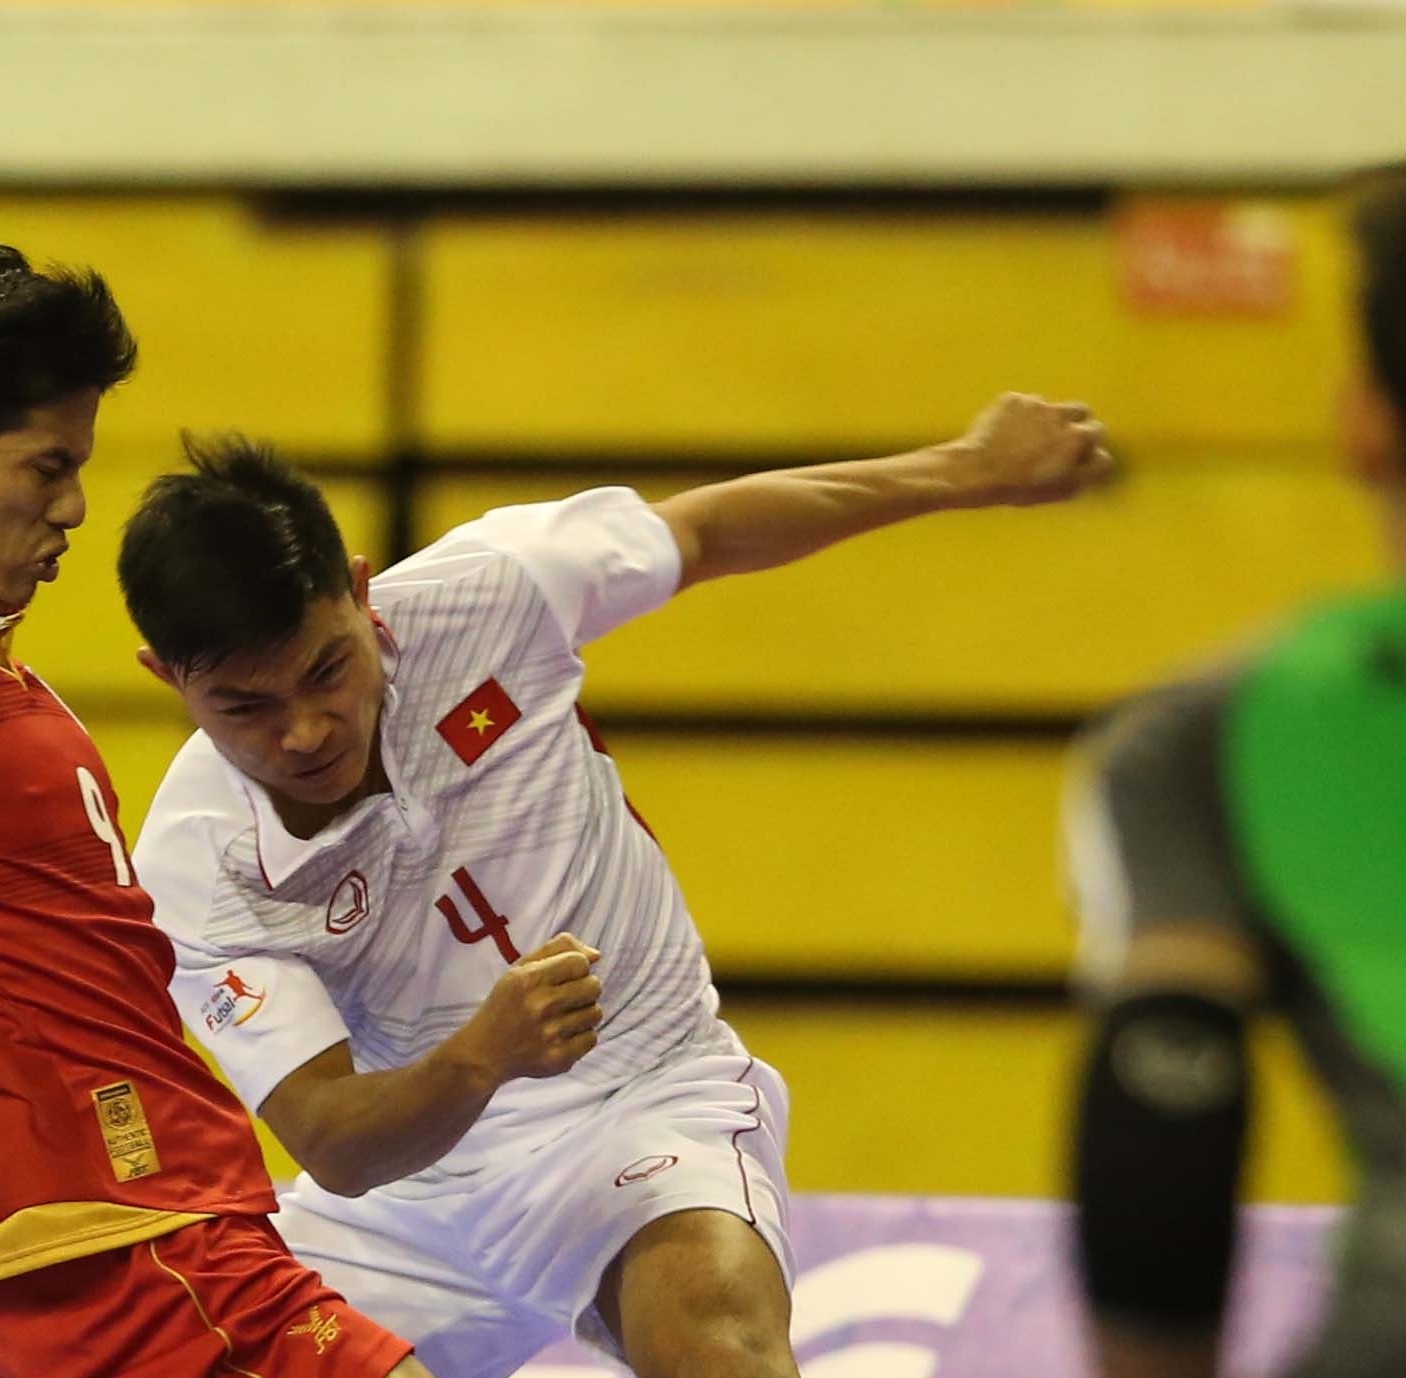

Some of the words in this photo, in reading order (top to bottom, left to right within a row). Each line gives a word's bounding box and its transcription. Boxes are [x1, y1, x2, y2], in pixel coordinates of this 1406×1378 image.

[76, 767, 131, 888] 9
[434, 866, 521, 964] 4
[205, 996, 236, 1032] Futsal
